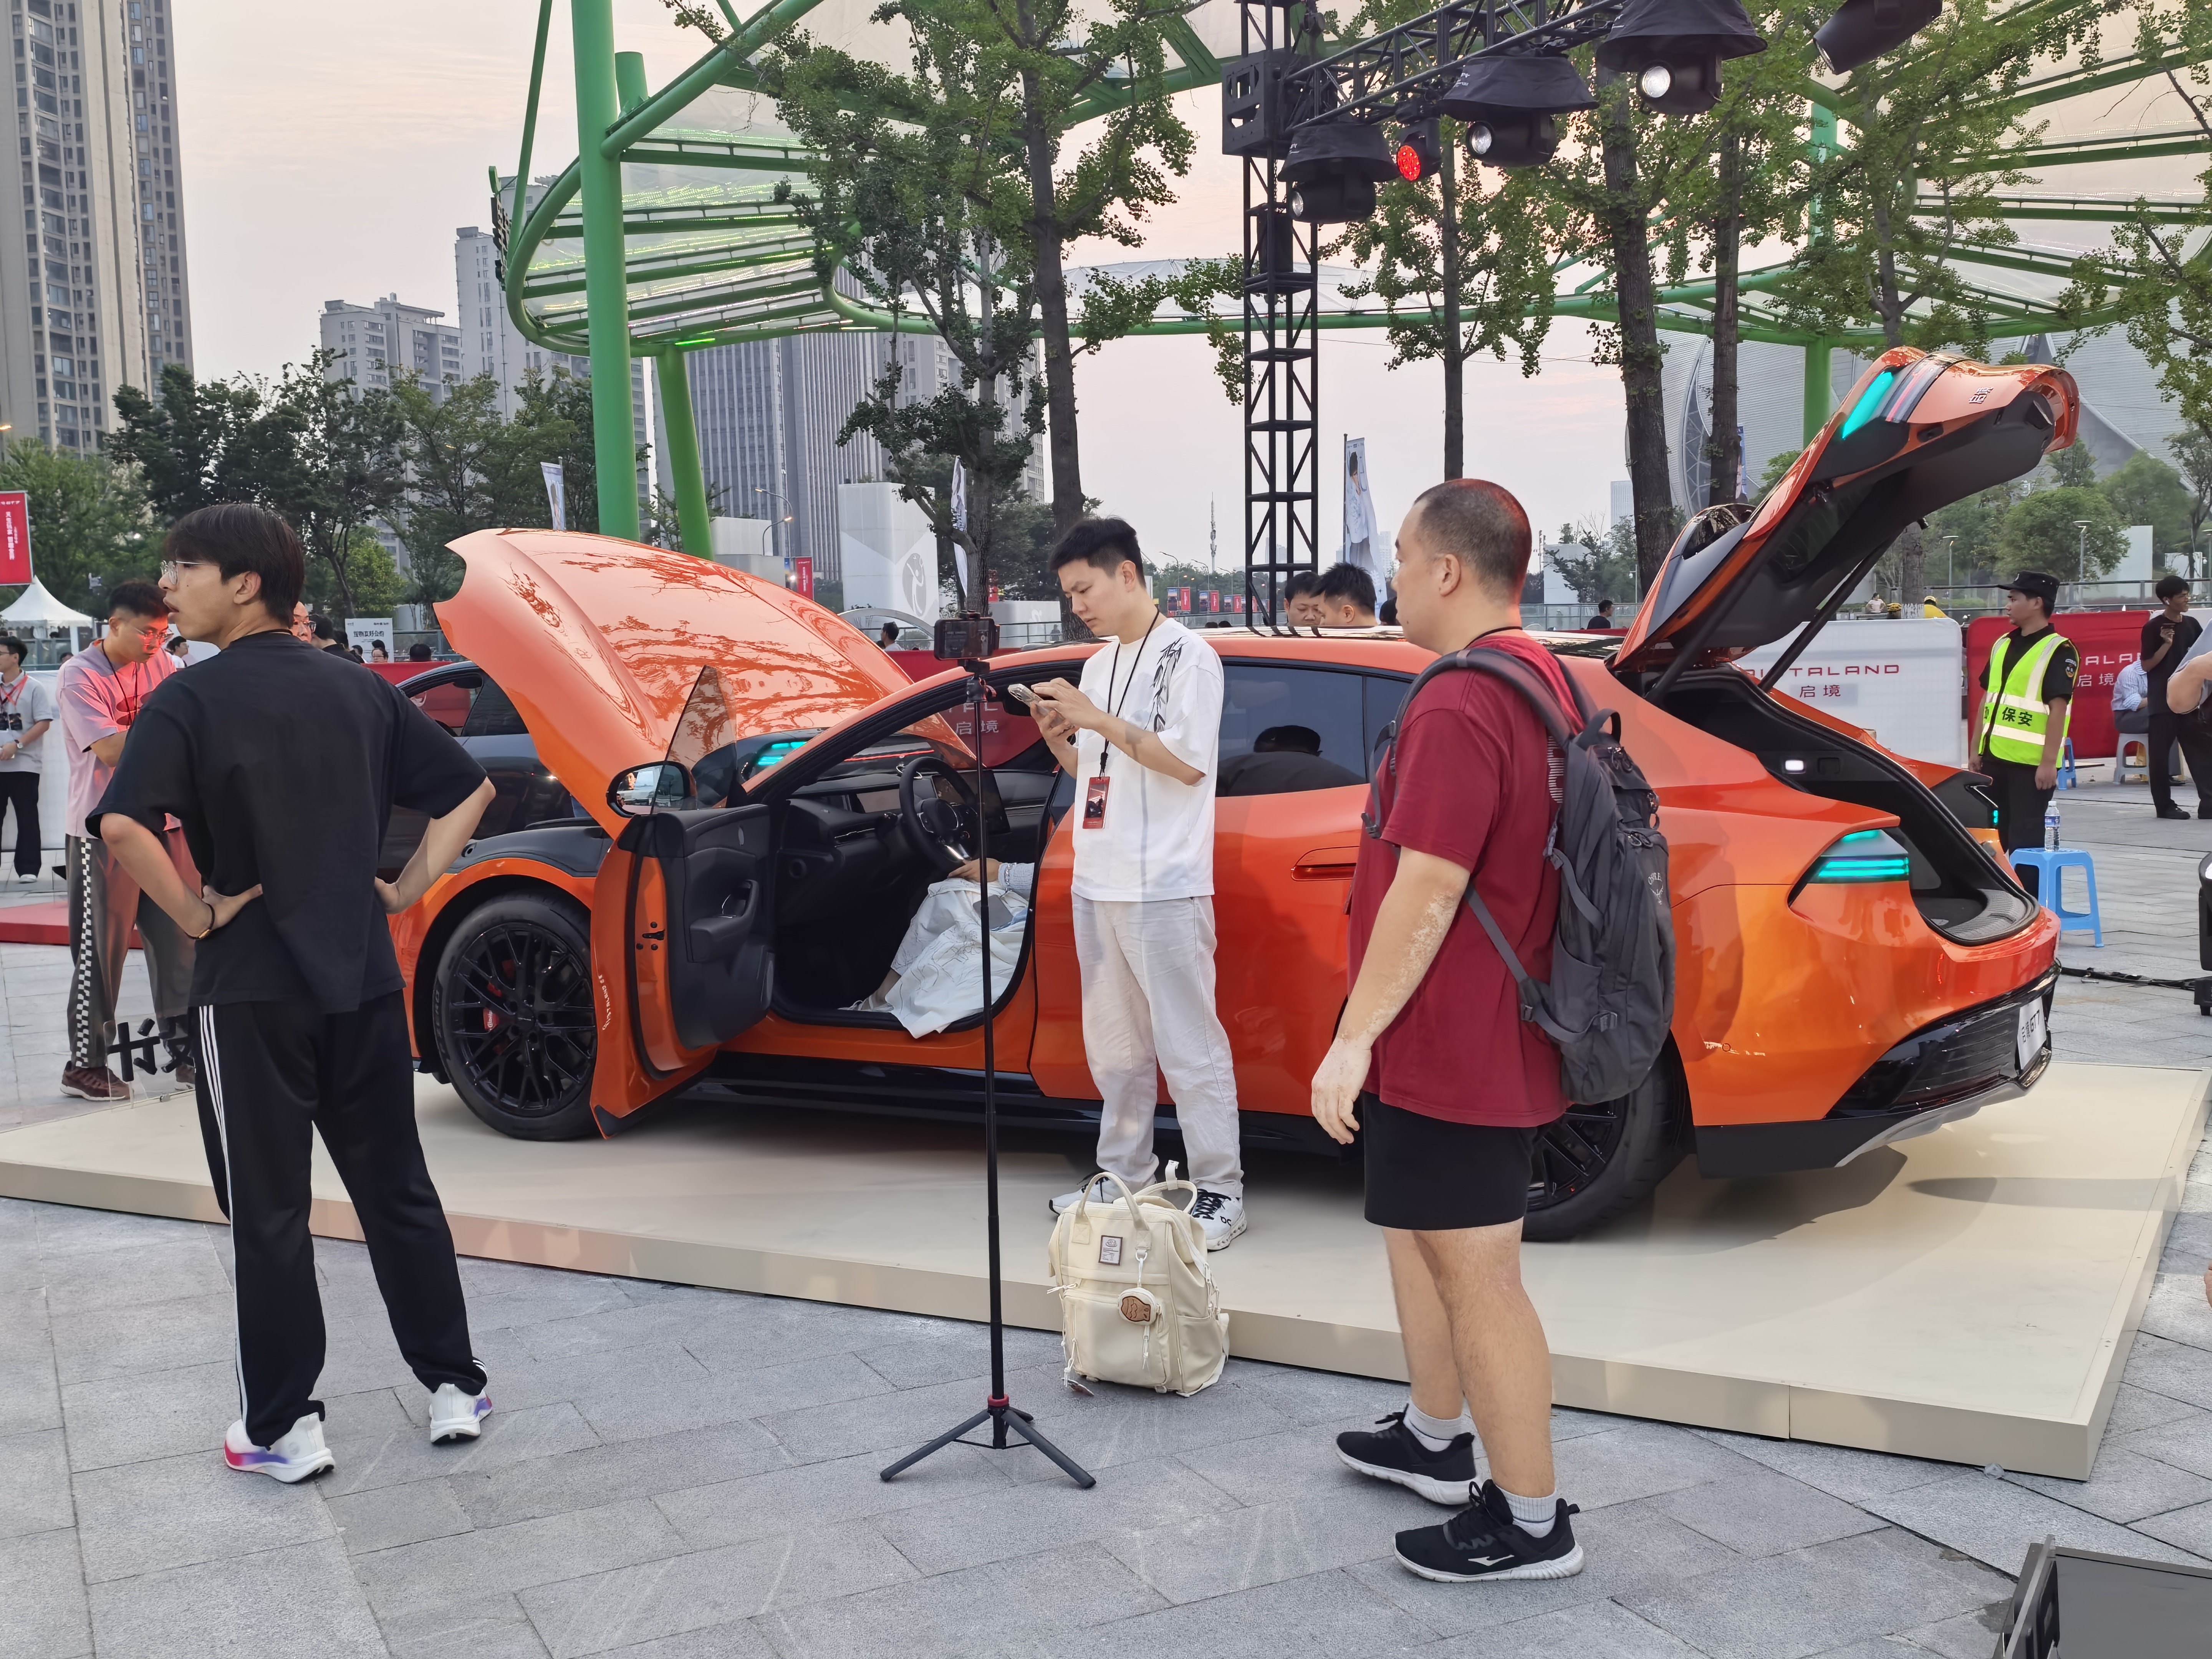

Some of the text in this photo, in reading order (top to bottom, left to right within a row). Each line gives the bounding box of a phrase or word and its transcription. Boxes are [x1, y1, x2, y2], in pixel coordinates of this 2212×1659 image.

[1744, 664, 1899, 678] AITALAND
[2077, 673, 2114, 687] 启境
[1800, 684, 1841, 698] 启境
[2002, 707, 2033, 726] 保安
[955, 720, 999, 735] 启境
